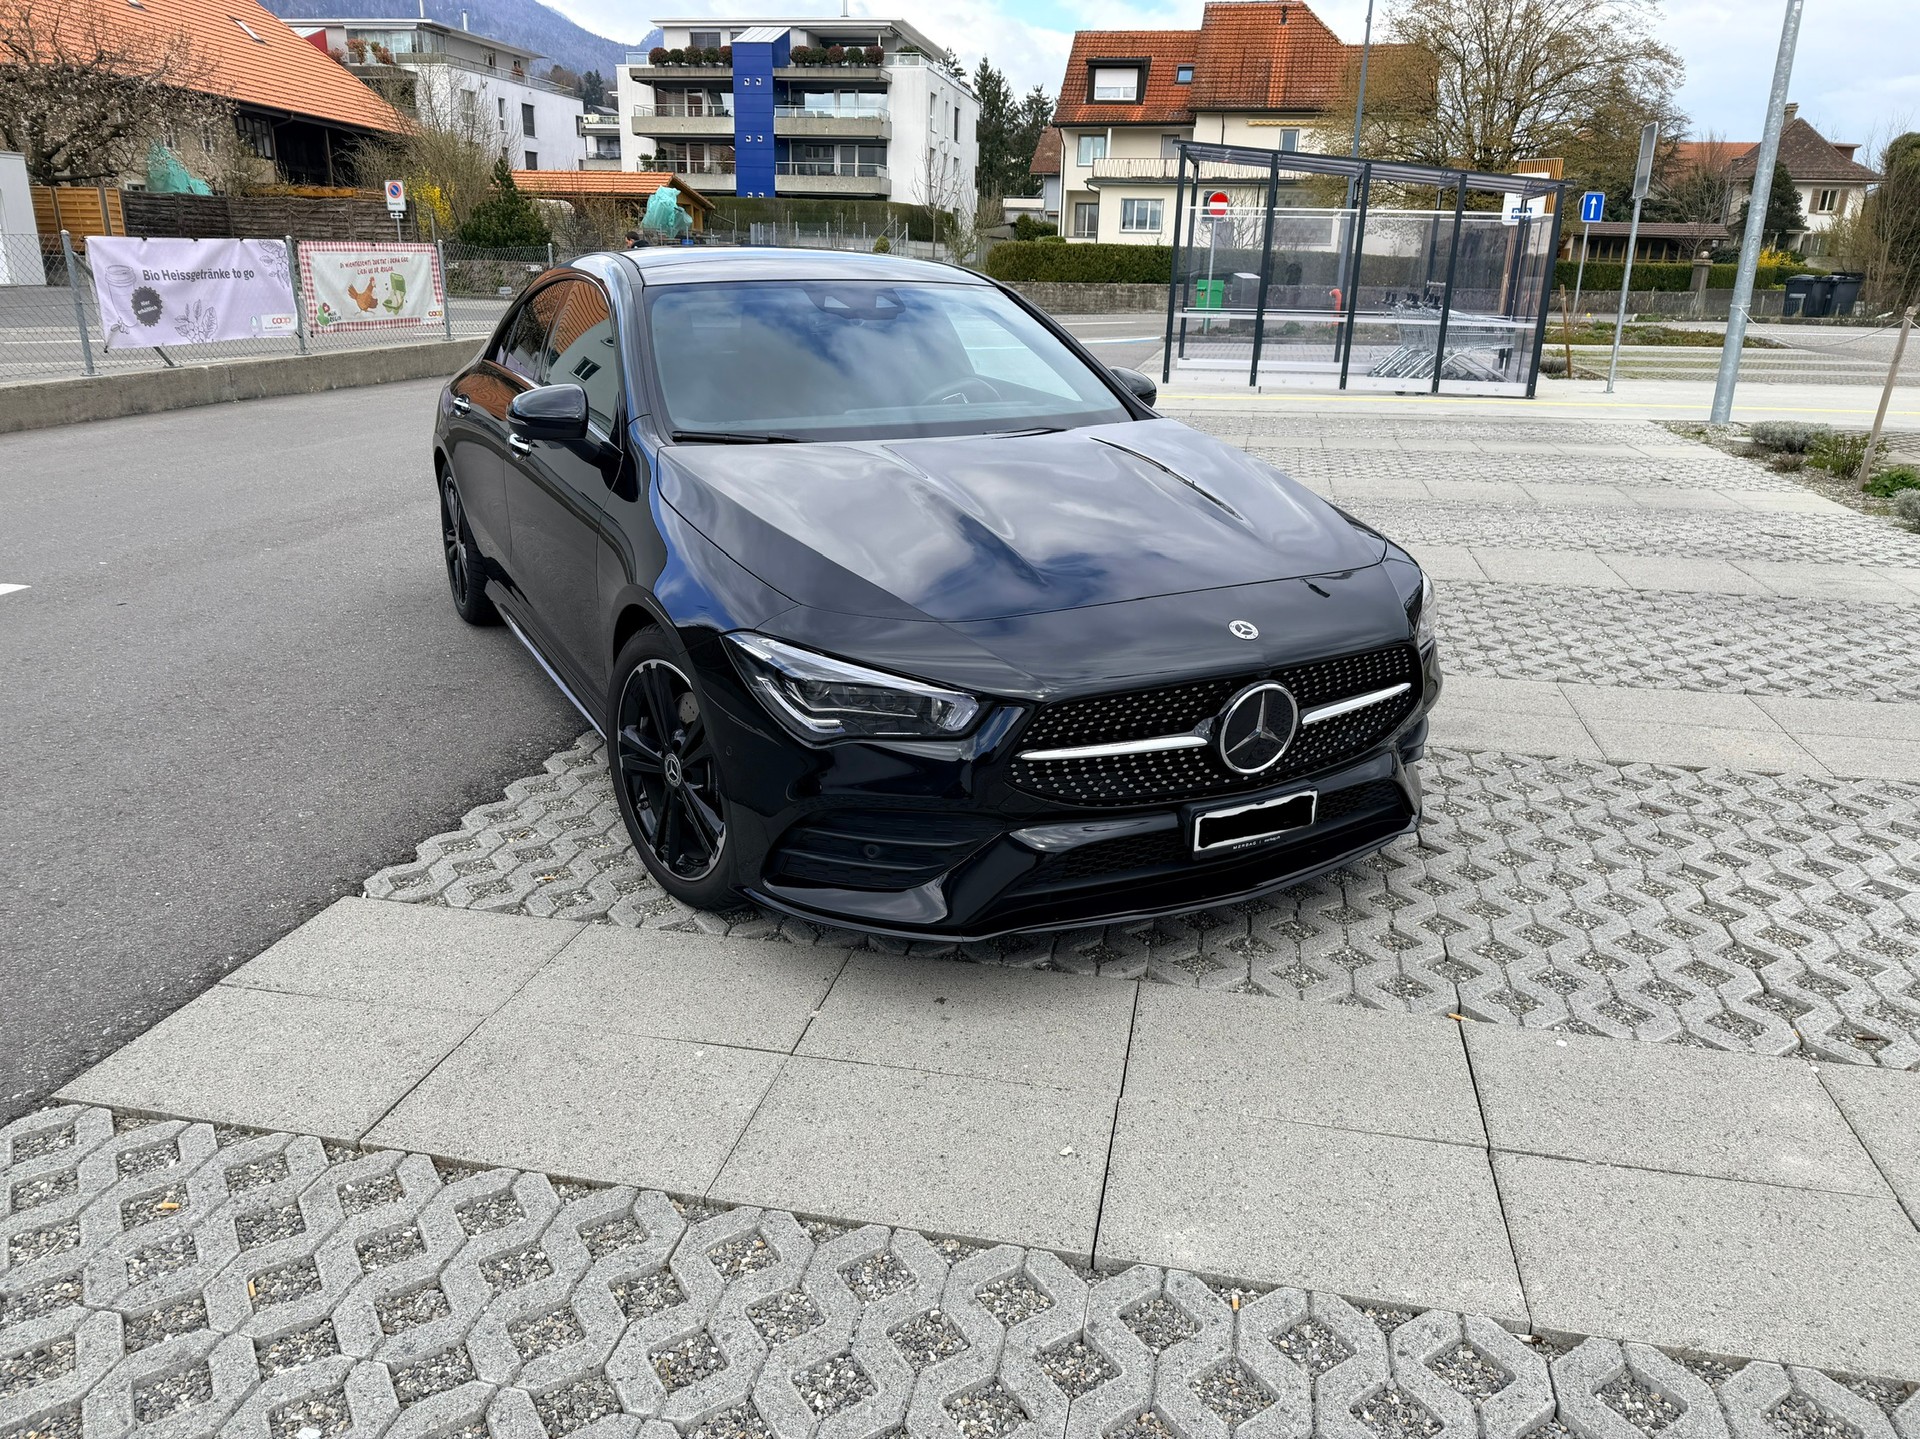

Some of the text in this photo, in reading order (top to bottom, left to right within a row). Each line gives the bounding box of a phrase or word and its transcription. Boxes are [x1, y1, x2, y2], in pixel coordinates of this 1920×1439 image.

[142, 268, 255, 282] Bio Heissgetränke to go
[272, 317, 291, 325] coop
